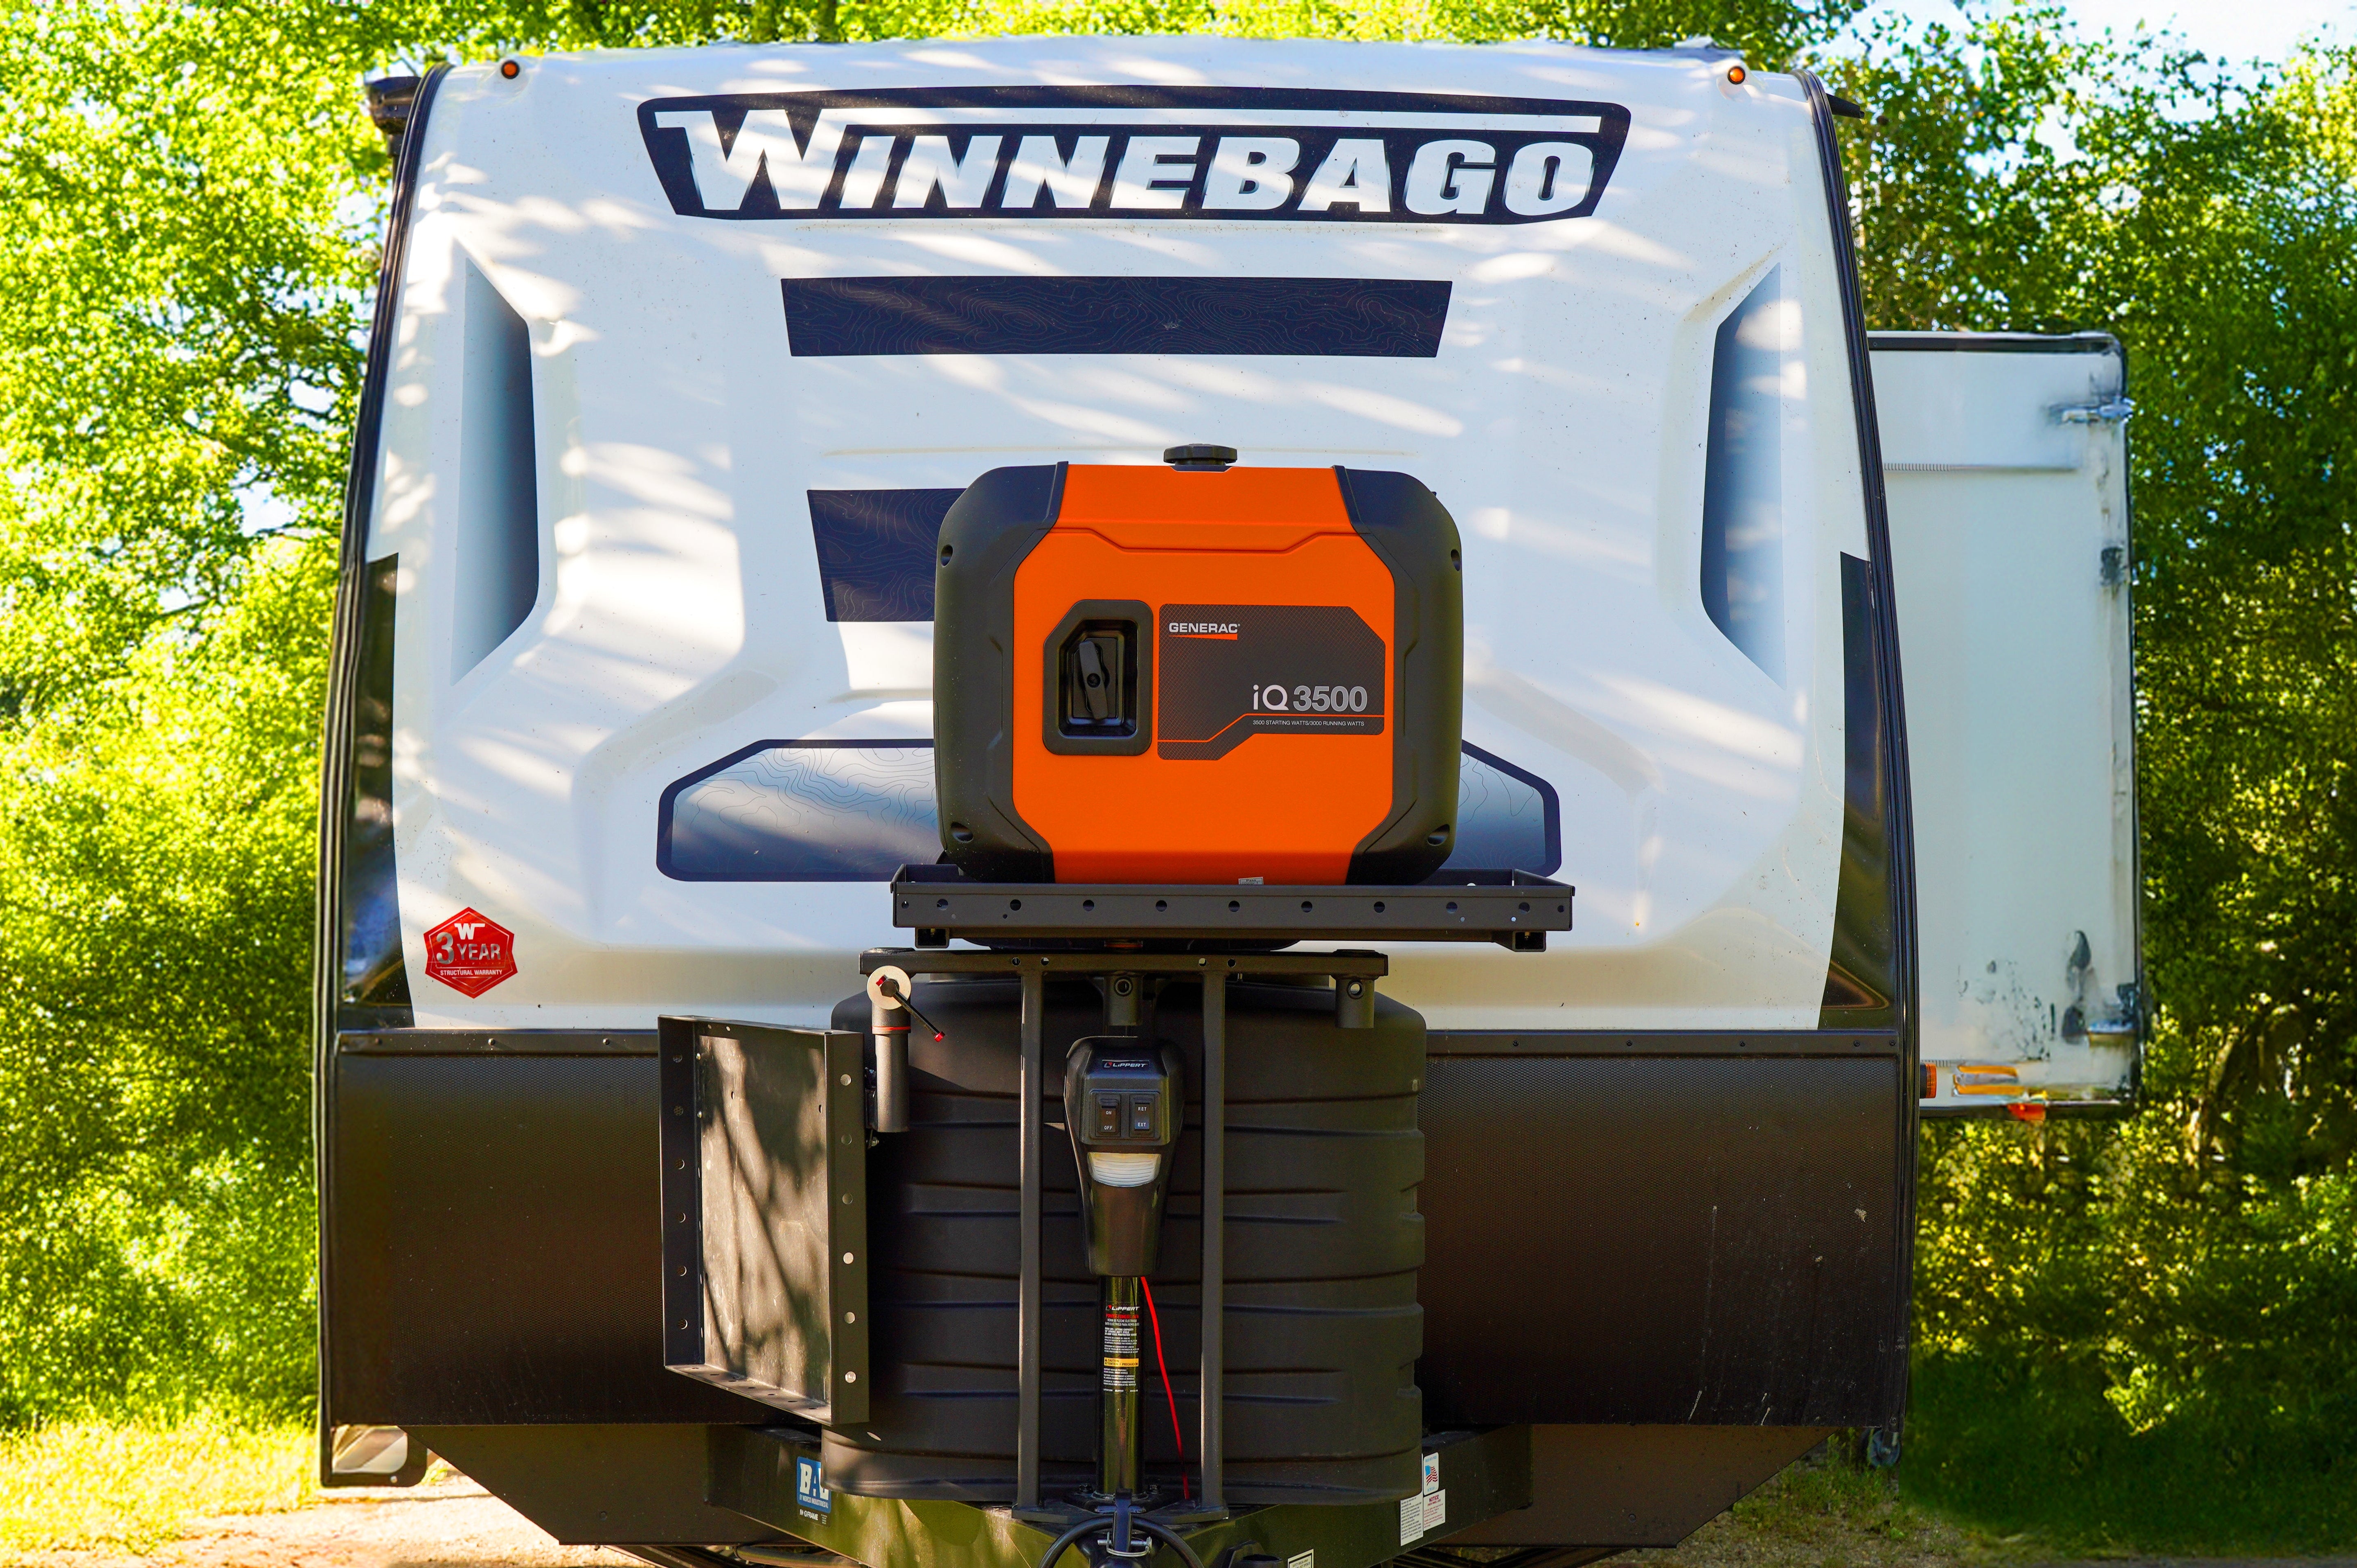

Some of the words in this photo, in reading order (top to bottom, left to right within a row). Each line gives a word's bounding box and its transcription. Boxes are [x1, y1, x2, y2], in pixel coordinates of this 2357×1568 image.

[656, 108, 1601, 216] WINNEBAGO
[1169, 622, 1238, 633] GENERAC
[1253, 684, 1289, 711] iQ
[1293, 685, 1368, 712] 3500
[436, 932, 454, 964] 3
[457, 943, 501, 960] YEAR
[1429, 1494, 1440, 1503] NOTICE!
